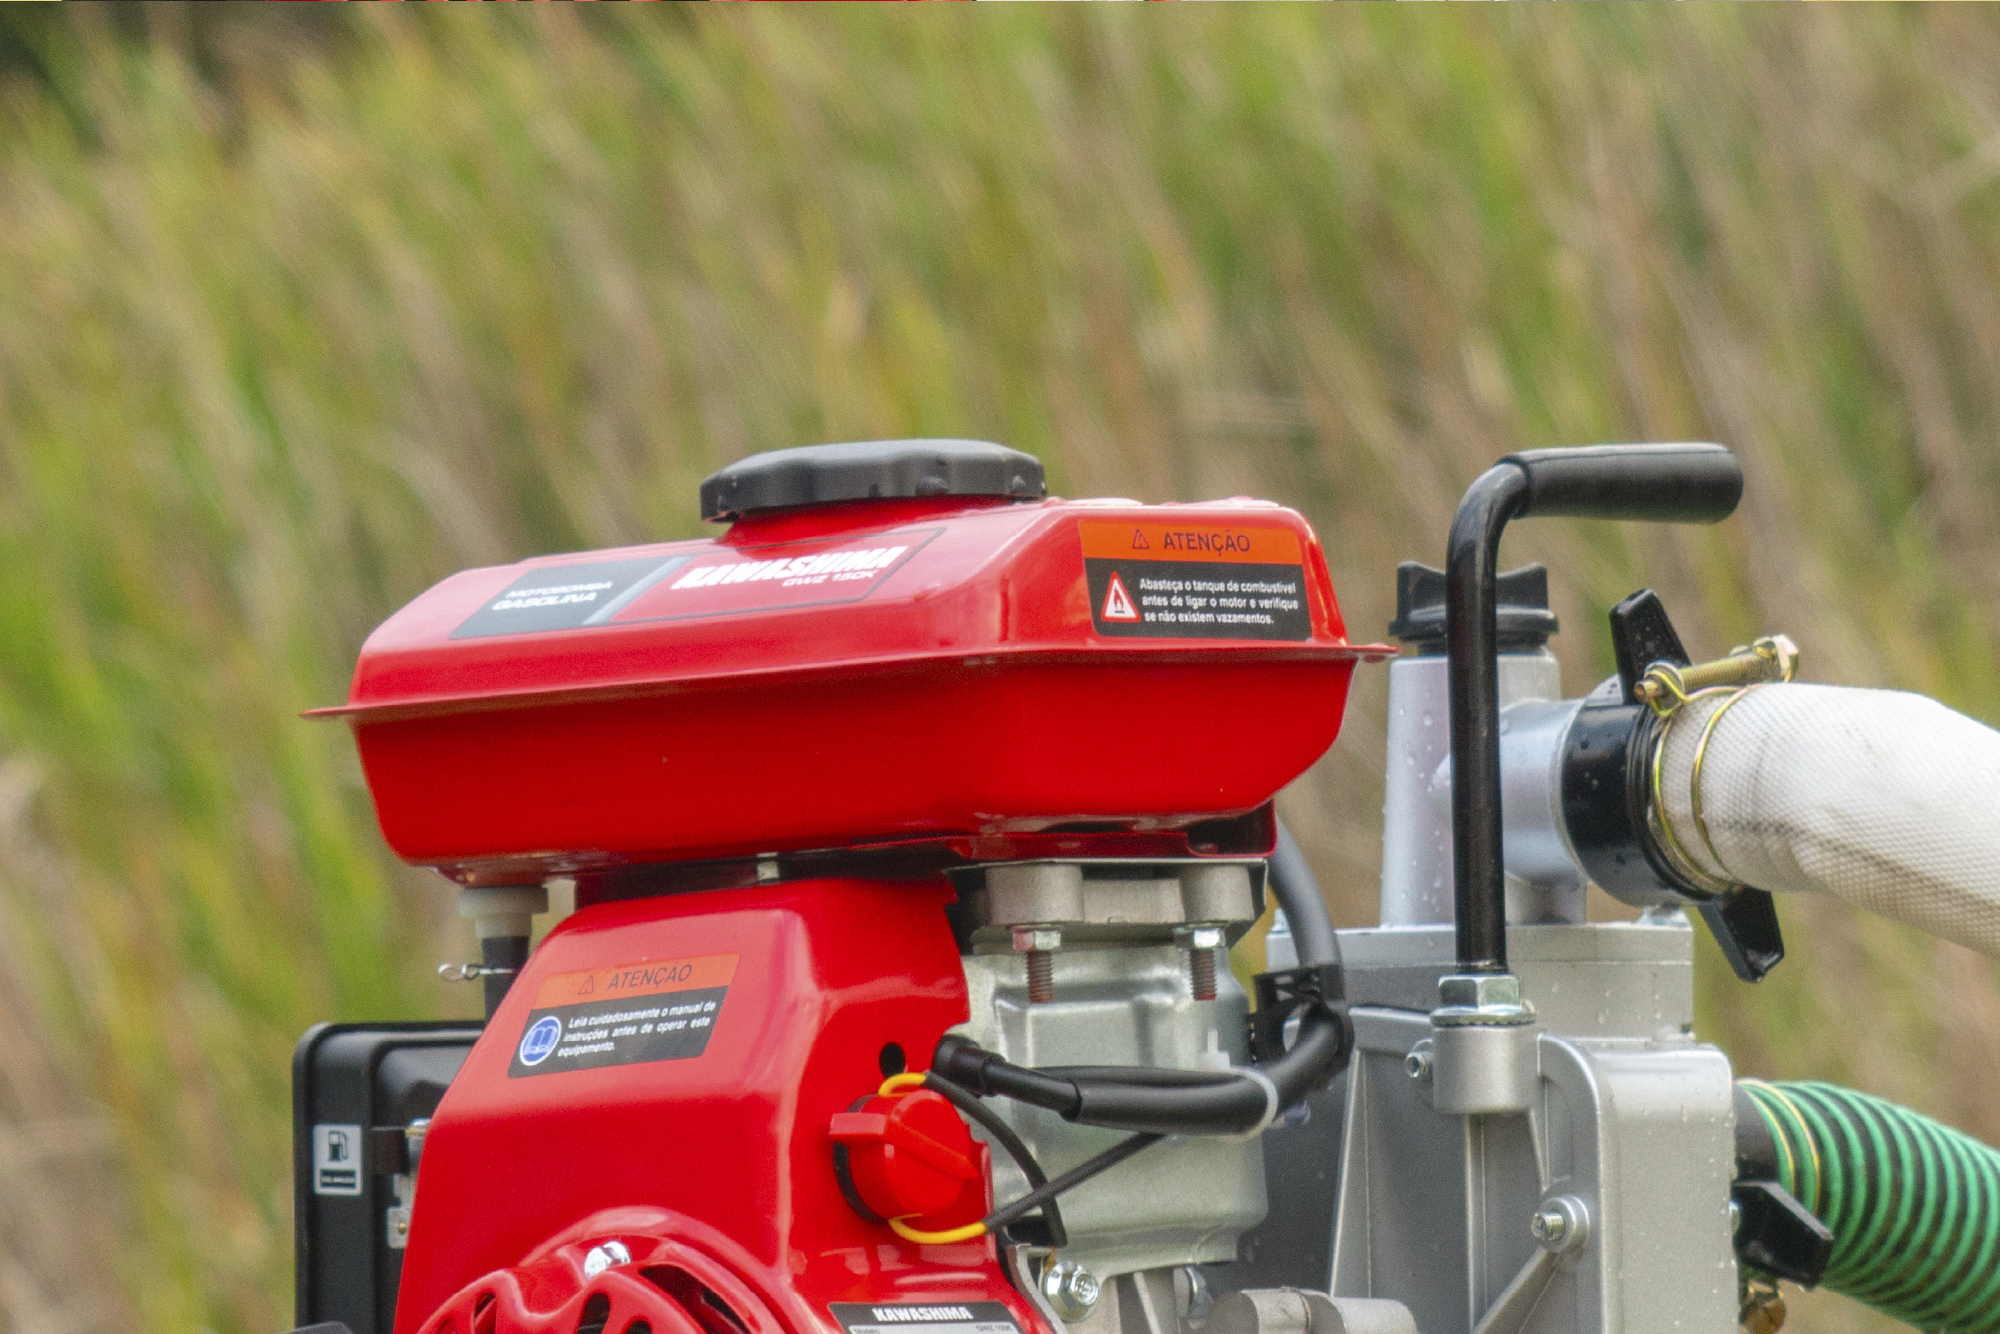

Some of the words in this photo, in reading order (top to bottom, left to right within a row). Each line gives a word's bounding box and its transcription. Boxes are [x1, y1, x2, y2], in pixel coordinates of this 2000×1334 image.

[1163, 529, 1251, 557] ATENÇÃO
[670, 546, 908, 589] KAWASHIMA
[1139, 578, 1184, 594] Abasteça
[1184, 581, 1192, 591] o
[1192, 580, 1226, 594] tanque
[1226, 581, 1240, 592] de
[491, 592, 597, 611] GASOLINA
[1142, 595, 1169, 606] antes
[1170, 595, 1184, 607] de
[1185, 595, 1208, 610] ligar
[1209, 597, 1218, 608] o
[1219, 597, 1247, 609] motor
[1249, 598, 1257, 609] e
[1258, 597, 1300, 612] verifique
[1144, 611, 1157, 622] se
[1157, 610, 1177, 623] não
[1178, 611, 1215, 623] existem
[1216, 613, 1274, 625] vazamentos.
[568, 1017, 588, 1029] Leia
[588, 1007, 660, 1026] cuidadosamente
[661, 1007, 669, 1017] o
[669, 1001, 704, 1016] manual
[703, 1001, 716, 1012] de
[611, 1025, 638, 1037] antes
[640, 1023, 654, 1034] de
[656, 1020, 687, 1034] operar
[690, 1016, 711, 1029] este
[872, 1306, 974, 1322] KAWASHIMA
